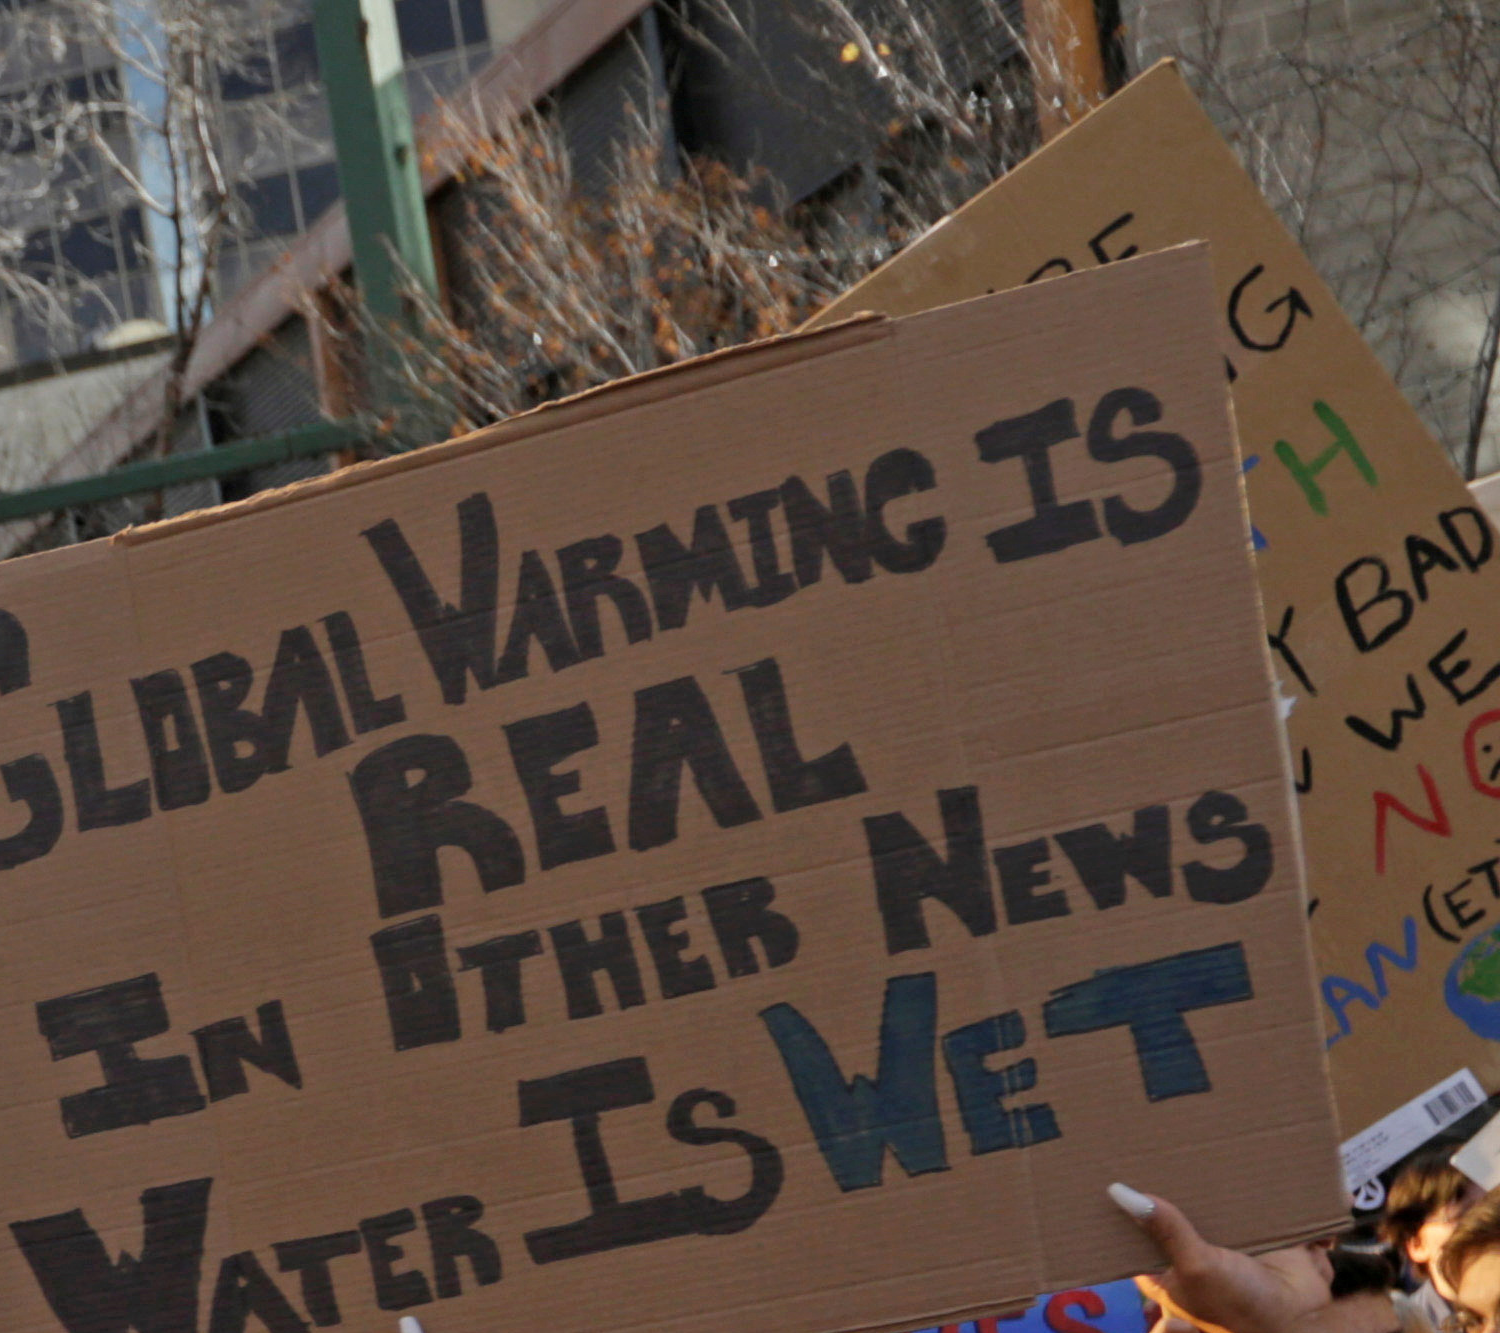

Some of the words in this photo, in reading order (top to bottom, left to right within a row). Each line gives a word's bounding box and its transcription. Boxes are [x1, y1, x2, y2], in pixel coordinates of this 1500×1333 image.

[358, 445, 946, 704] WARMING
[975, 386, 1202, 565] IS
[1335, 506, 1494, 653] BAD
[348, 657, 867, 917] REAL
[1344, 629, 1500, 751] WE
[35, 972, 302, 1139] IN
[368, 872, 799, 1054] OTHER
[862, 783, 1277, 954] NEWS
[517, 1055, 786, 1262] IS
[759, 940, 1254, 1192] WET
